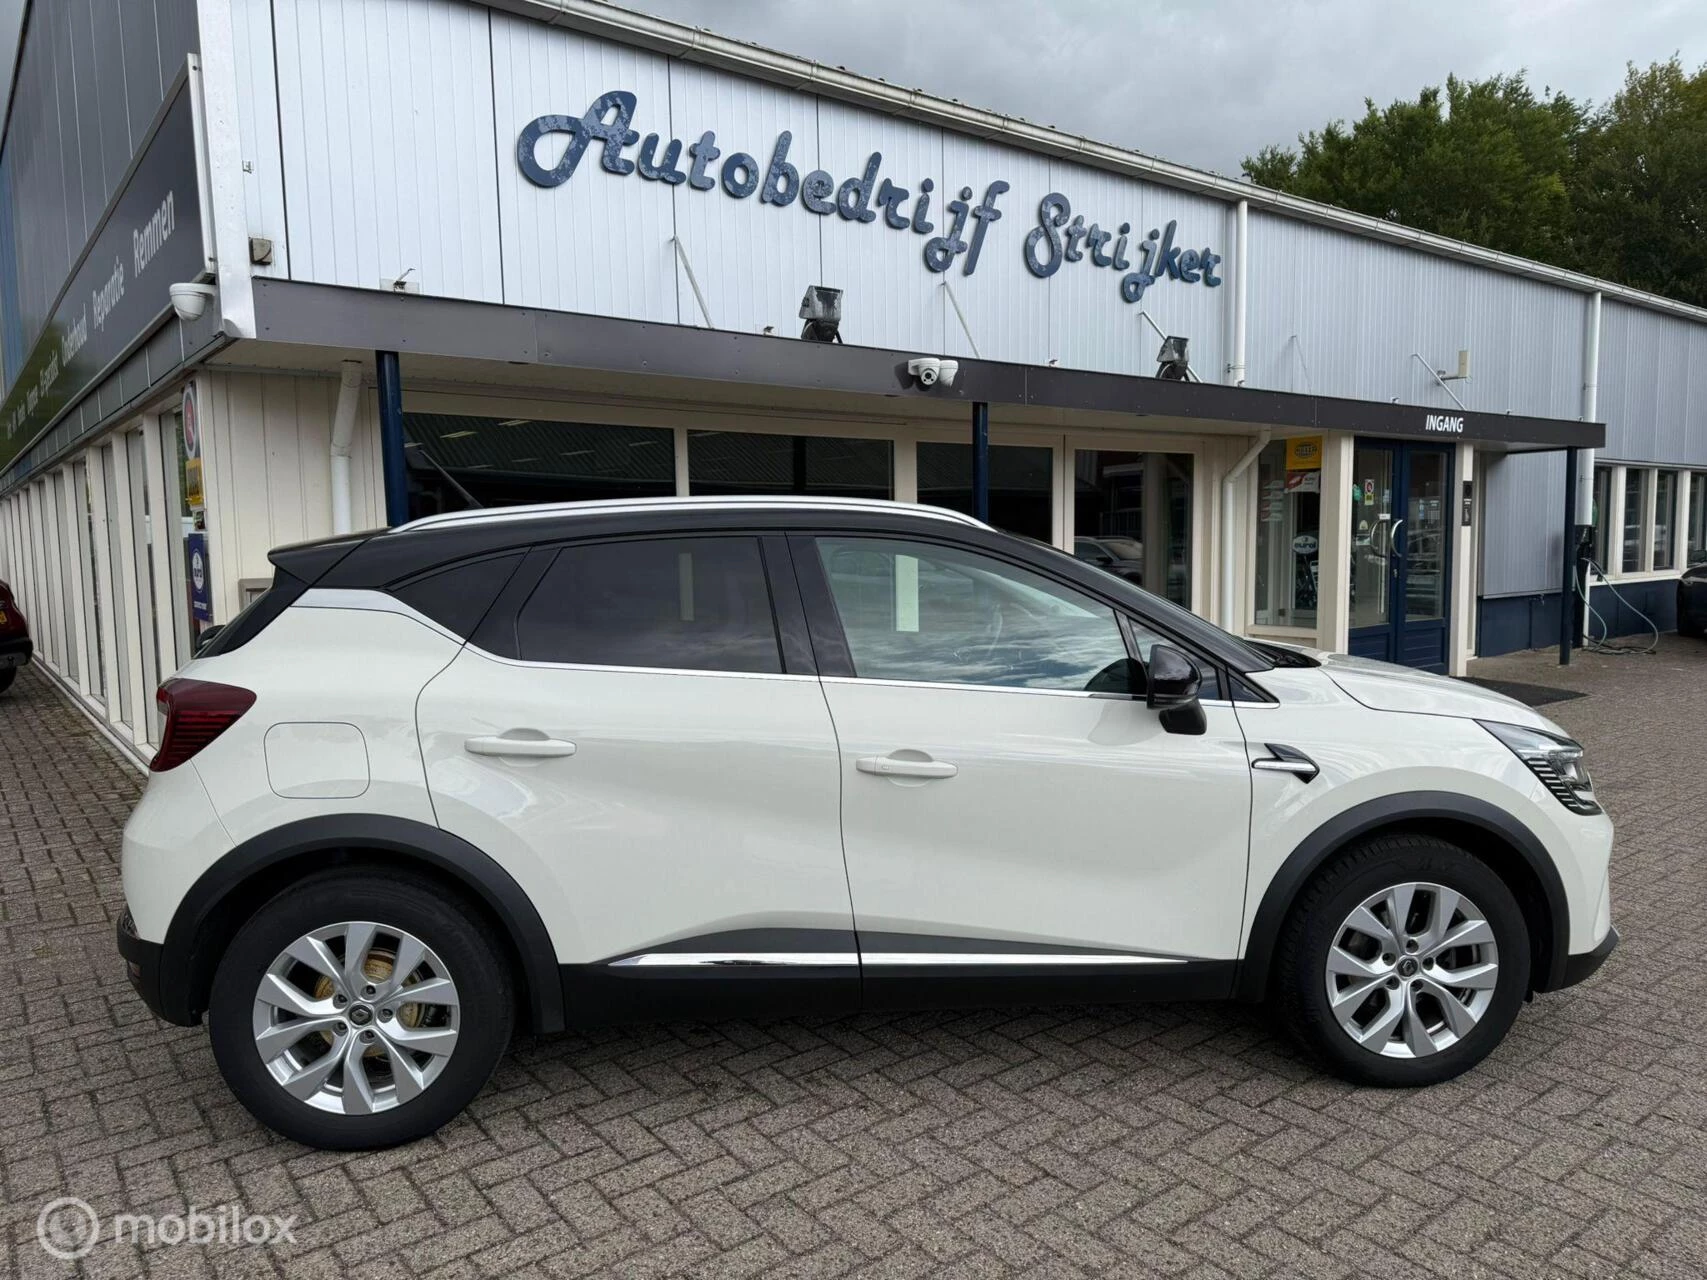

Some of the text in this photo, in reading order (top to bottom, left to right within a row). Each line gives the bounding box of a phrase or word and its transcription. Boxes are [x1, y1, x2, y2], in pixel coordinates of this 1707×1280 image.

[92, 255, 125, 333] Reparatie
[132, 190, 176, 278] Remmen
[516, 90, 1223, 303] Autobedrijf Strijker
[1425, 414, 1464, 433] INGANG
